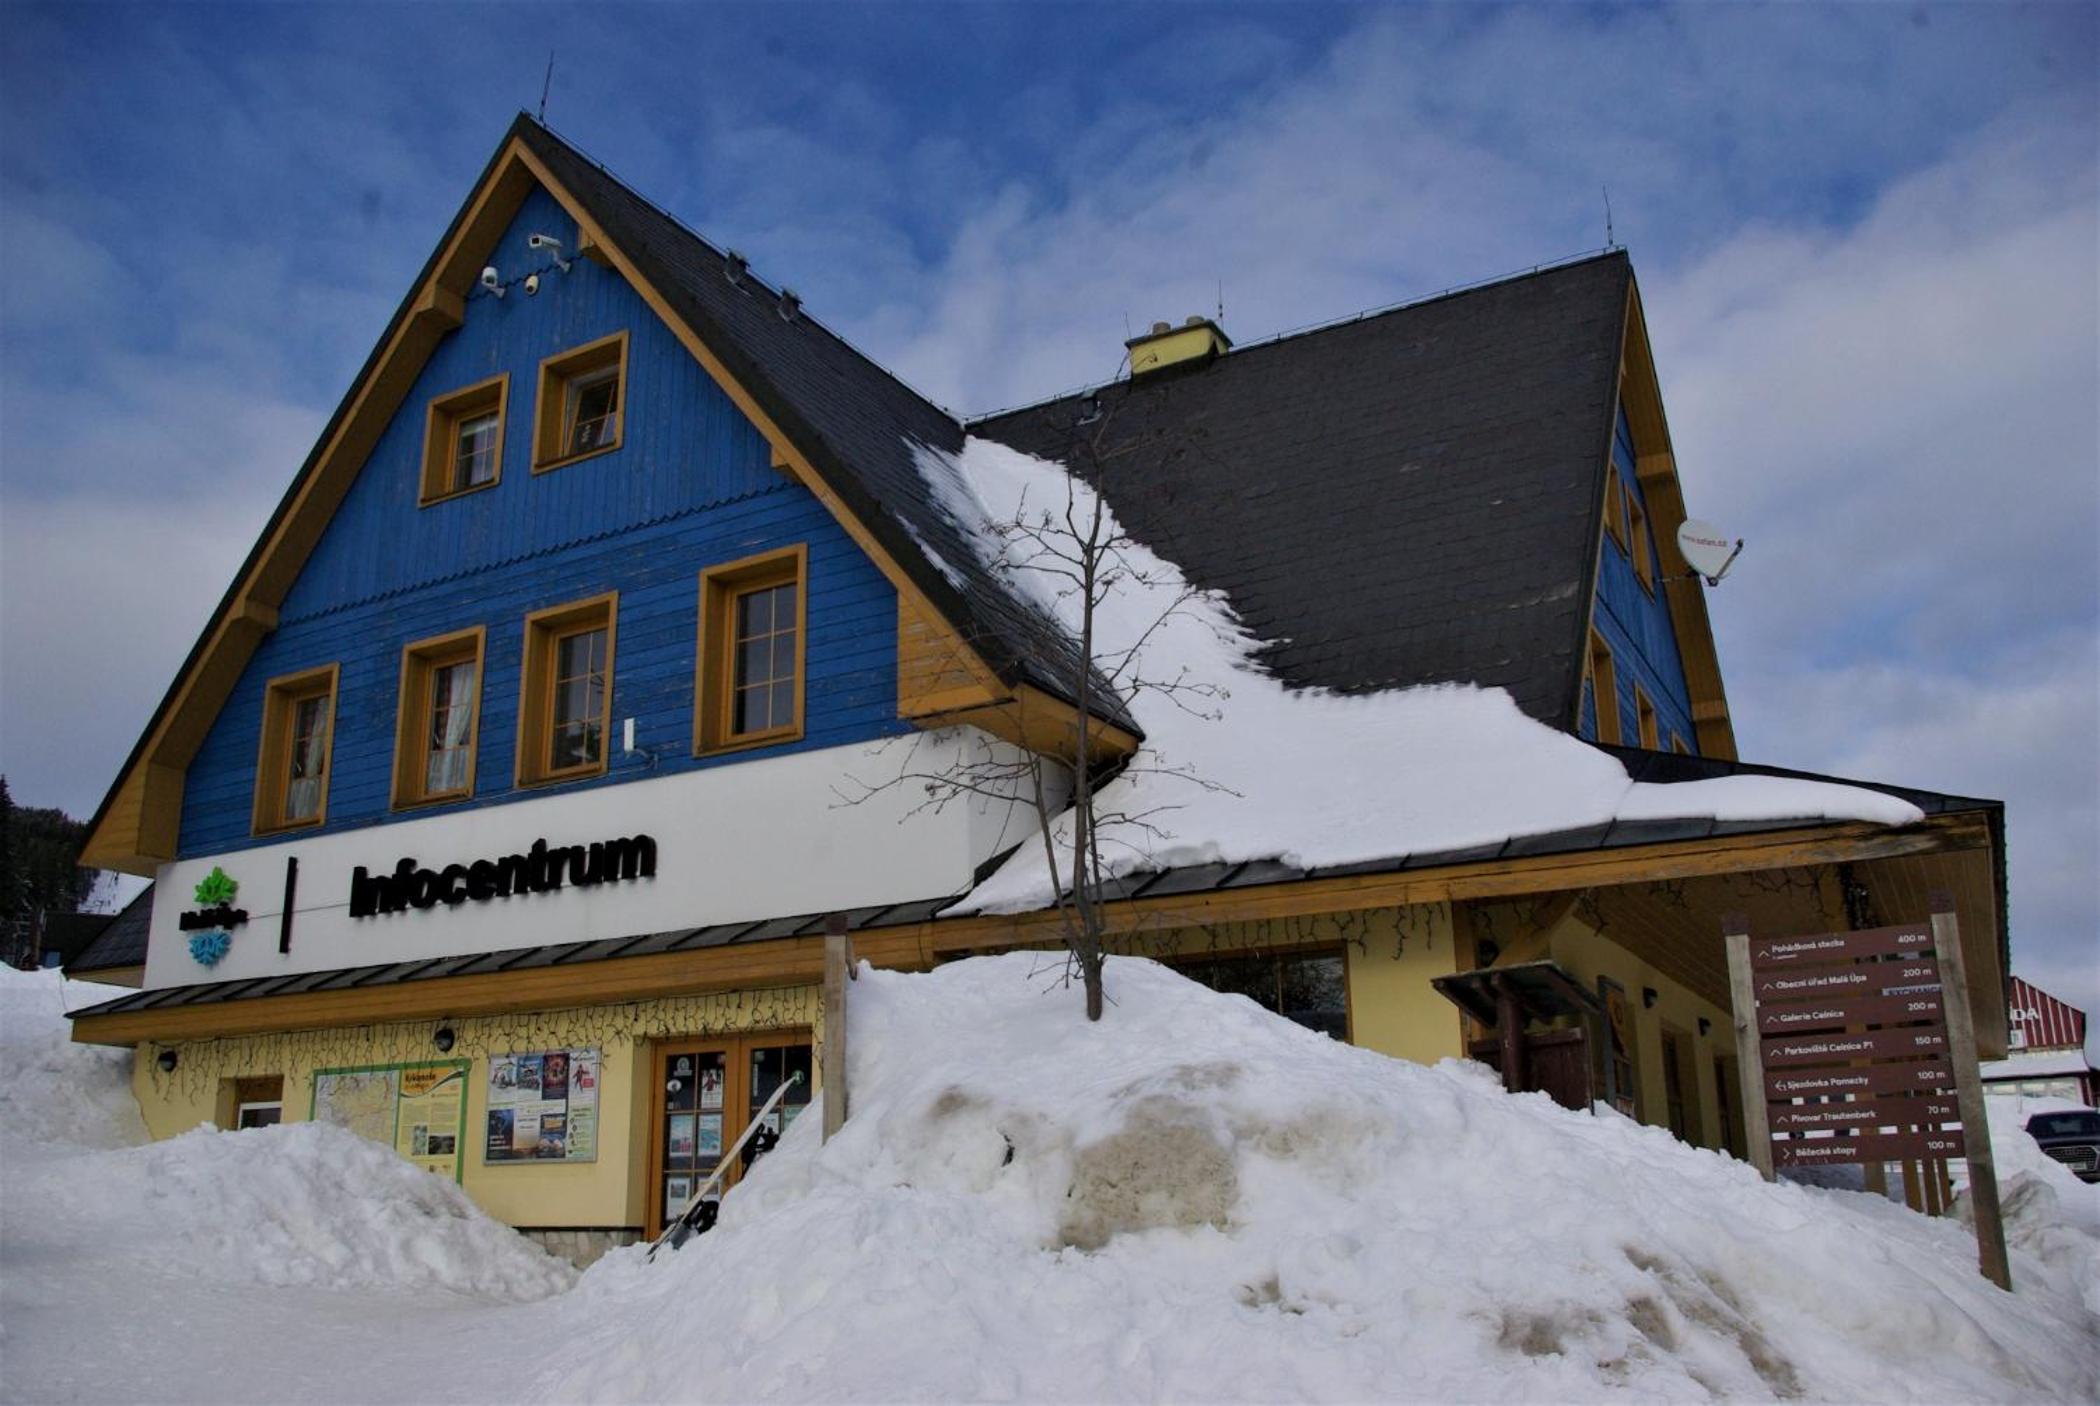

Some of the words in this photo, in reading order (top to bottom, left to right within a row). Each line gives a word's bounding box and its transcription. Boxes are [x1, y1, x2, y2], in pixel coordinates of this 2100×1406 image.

[350, 834, 657, 918] Infocentrum
[1917, 934, 1927, 942] m
[1776, 979, 1807, 989] Obecní
[1849, 972, 1868, 984] Úpa
[1903, 968, 1921, 978] 200
[1922, 968, 1932, 976] m
[1780, 1012, 1812, 1022] Galerie
[1812, 1010, 1845, 1020] Celnice
[1908, 1002, 1926, 1012] 200
[1927, 1002, 1937, 1010] m
[1829, 1042, 1862, 1053] Celnice
[1914, 1036, 1932, 1046] 150
[1932, 1036, 1942, 1044] m
[1917, 1071, 1935, 1080] 100
[1936, 1070, 1946, 1079] m
[1791, 1113, 1822, 1123] Pivovar
[1927, 1105, 1939, 1115] 70
[1940, 1105, 1950, 1114] m
[1832, 1146, 1857, 1156] stopy
[1927, 1140, 1944, 1150] 100
[1945, 1140, 1956, 1149] m
